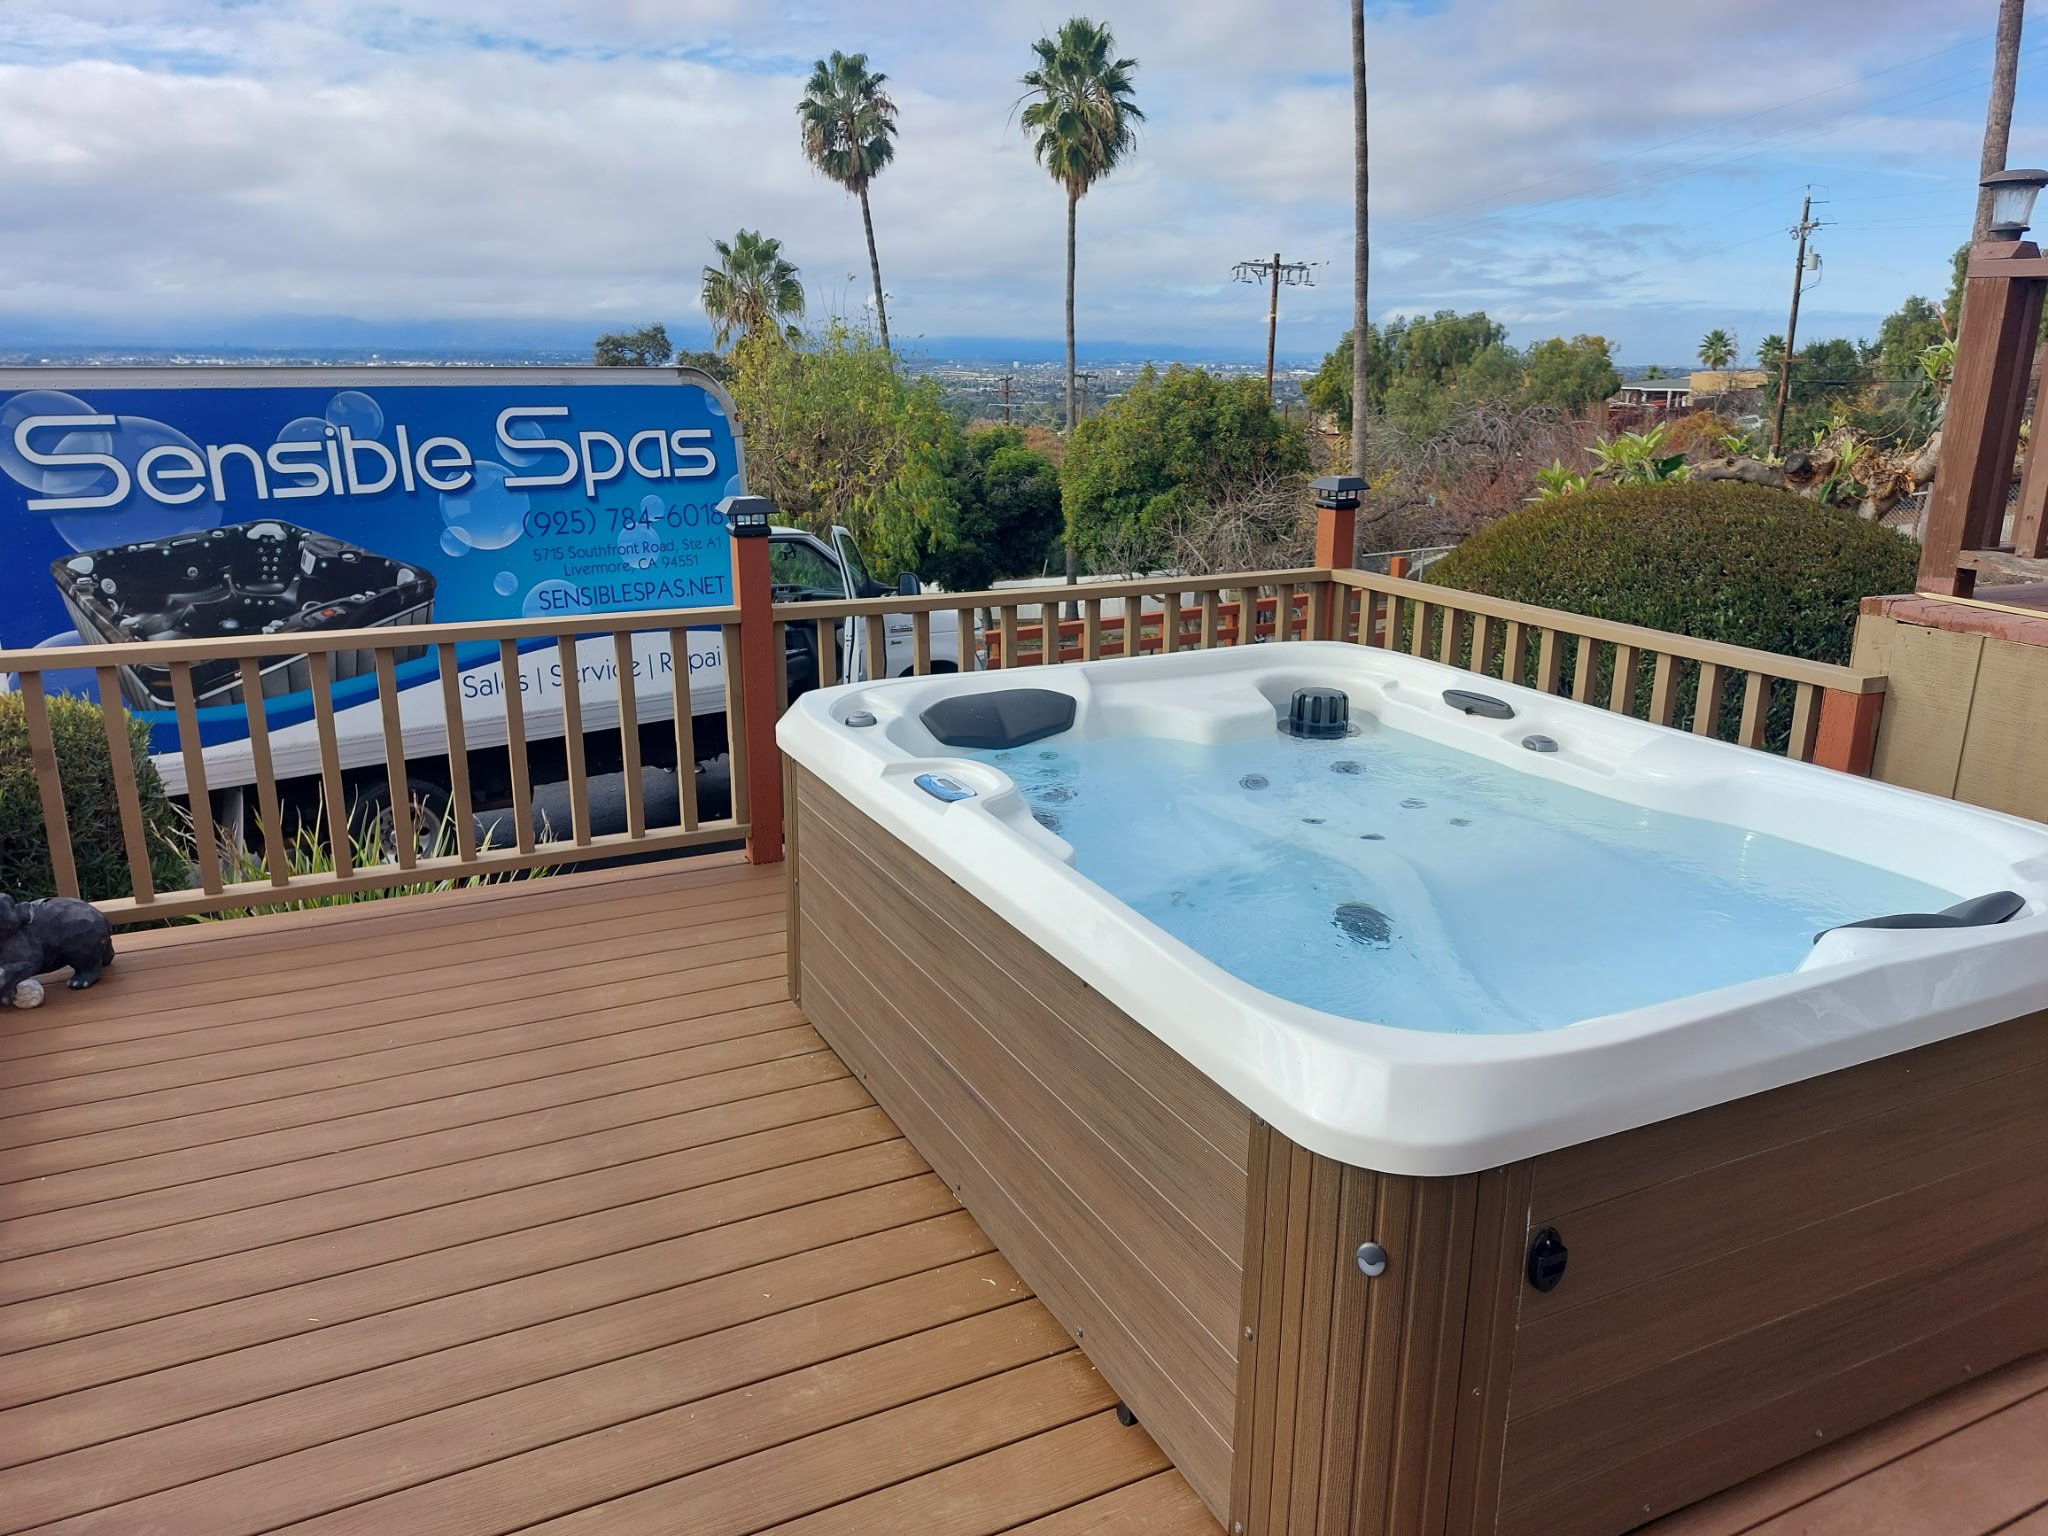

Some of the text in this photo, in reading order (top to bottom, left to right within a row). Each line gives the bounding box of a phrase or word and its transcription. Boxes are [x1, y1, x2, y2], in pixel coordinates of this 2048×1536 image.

[14, 406, 716, 511] Sensible Spas
[523, 502, 724, 538] (925) 784-6018
[533, 536, 722, 562] 5715 Southfront Road, Ste A1
[564, 554, 699, 577] Livermore, CA 94551
[539, 575, 725, 611] SENSIBLESPAS.NET
[462, 671, 529, 699] Sals
